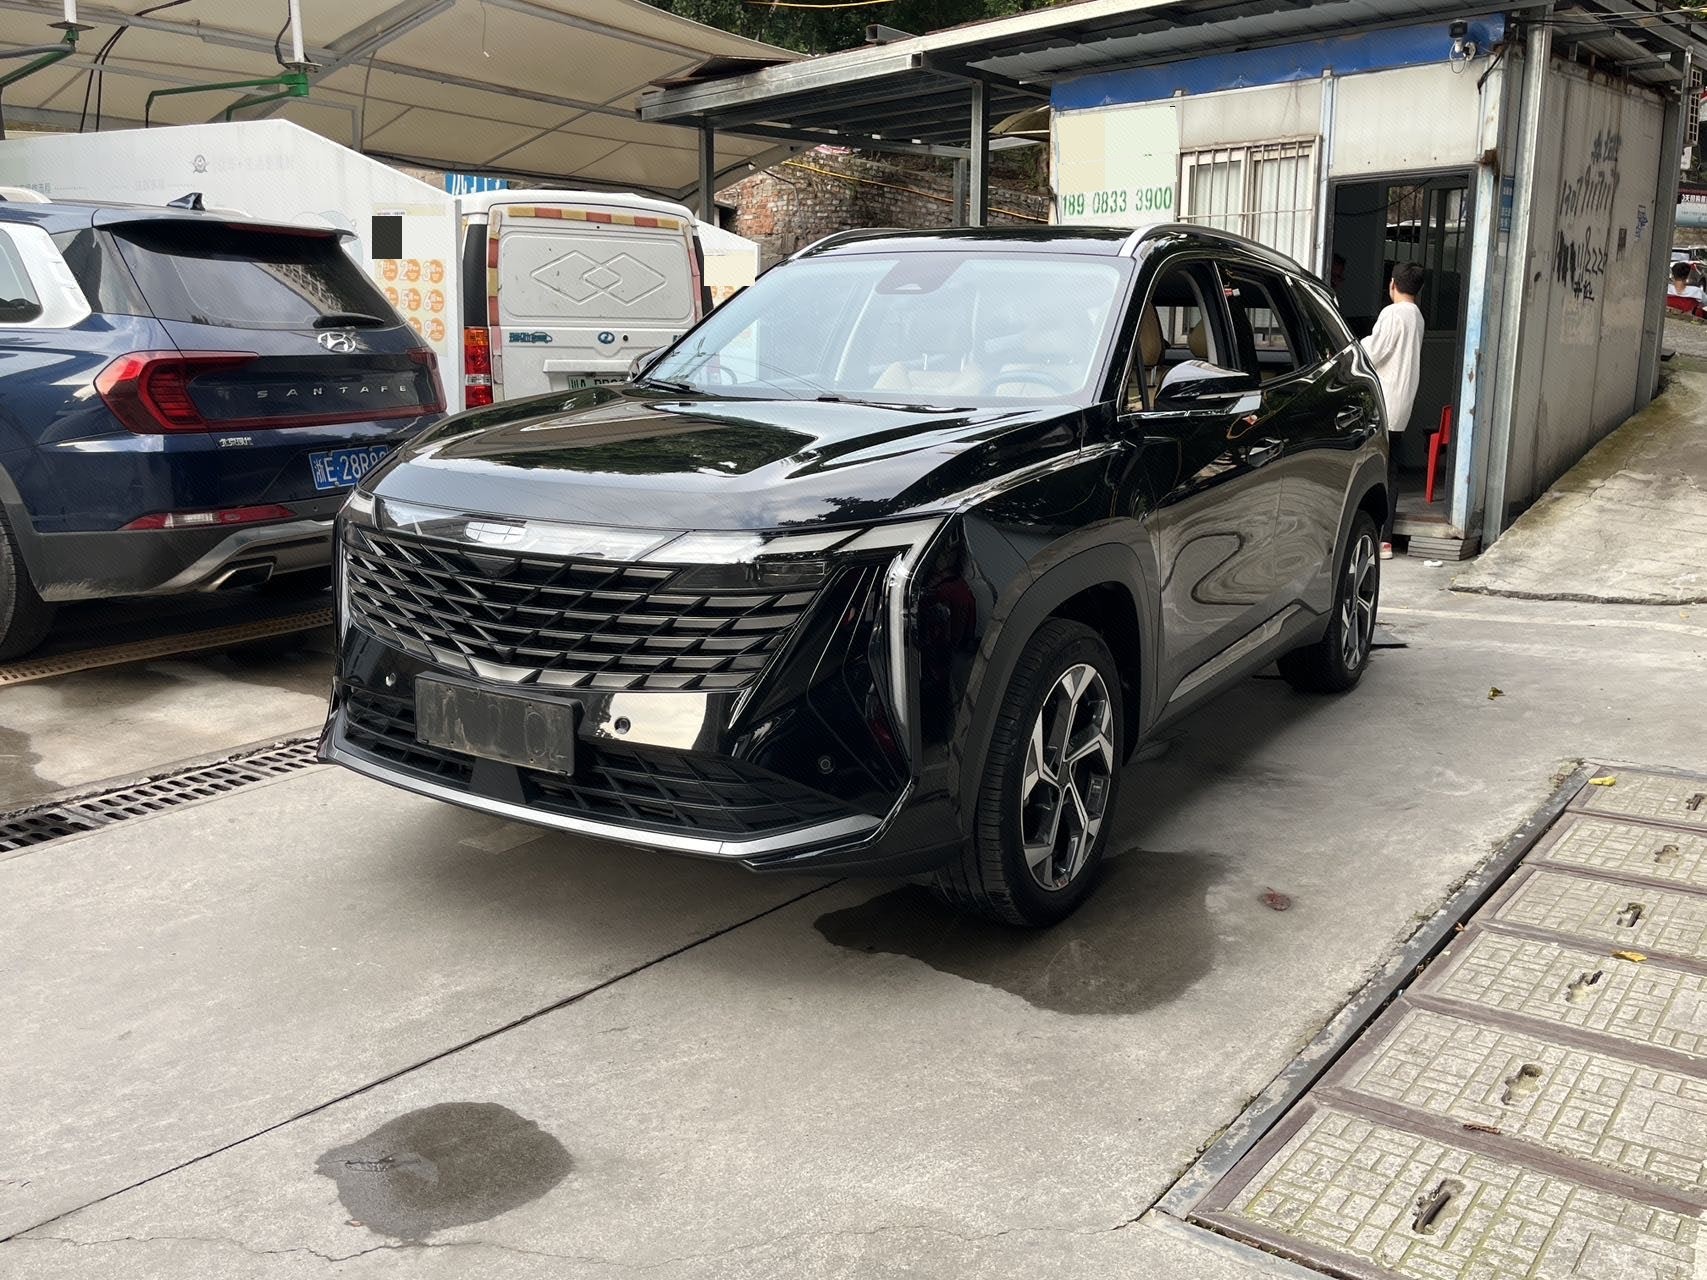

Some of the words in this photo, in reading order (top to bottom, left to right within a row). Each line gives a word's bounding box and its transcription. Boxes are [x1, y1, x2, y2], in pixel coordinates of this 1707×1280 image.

[1062, 193, 1086, 216] 189
[1092, 190, 1127, 214] 0833
[1135, 187, 1173, 211] 3900
